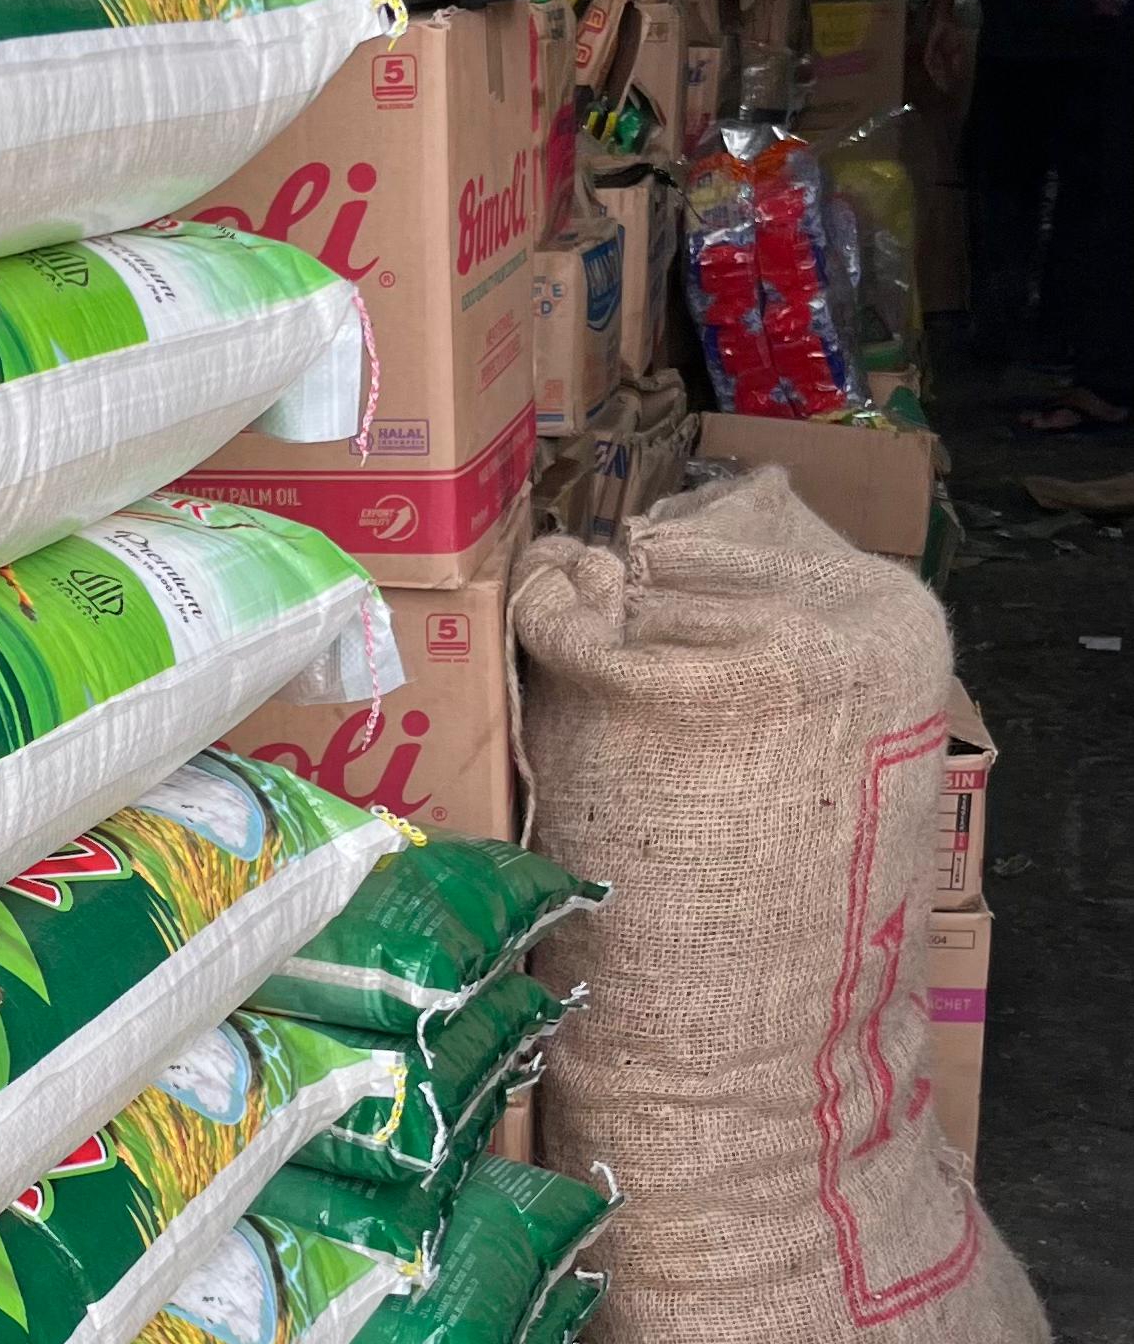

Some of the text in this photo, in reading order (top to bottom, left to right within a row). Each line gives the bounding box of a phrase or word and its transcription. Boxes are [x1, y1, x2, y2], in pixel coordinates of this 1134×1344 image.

[384, 59, 405, 84] 5
[455, 149, 528, 276] Bimoli
[378, 427, 425, 441] HALAL
[229, 487, 273, 506] PALM
[275, 487, 302, 507] OIL
[113, 529, 204, 620] Premium
[436, 618, 459, 642] 5
